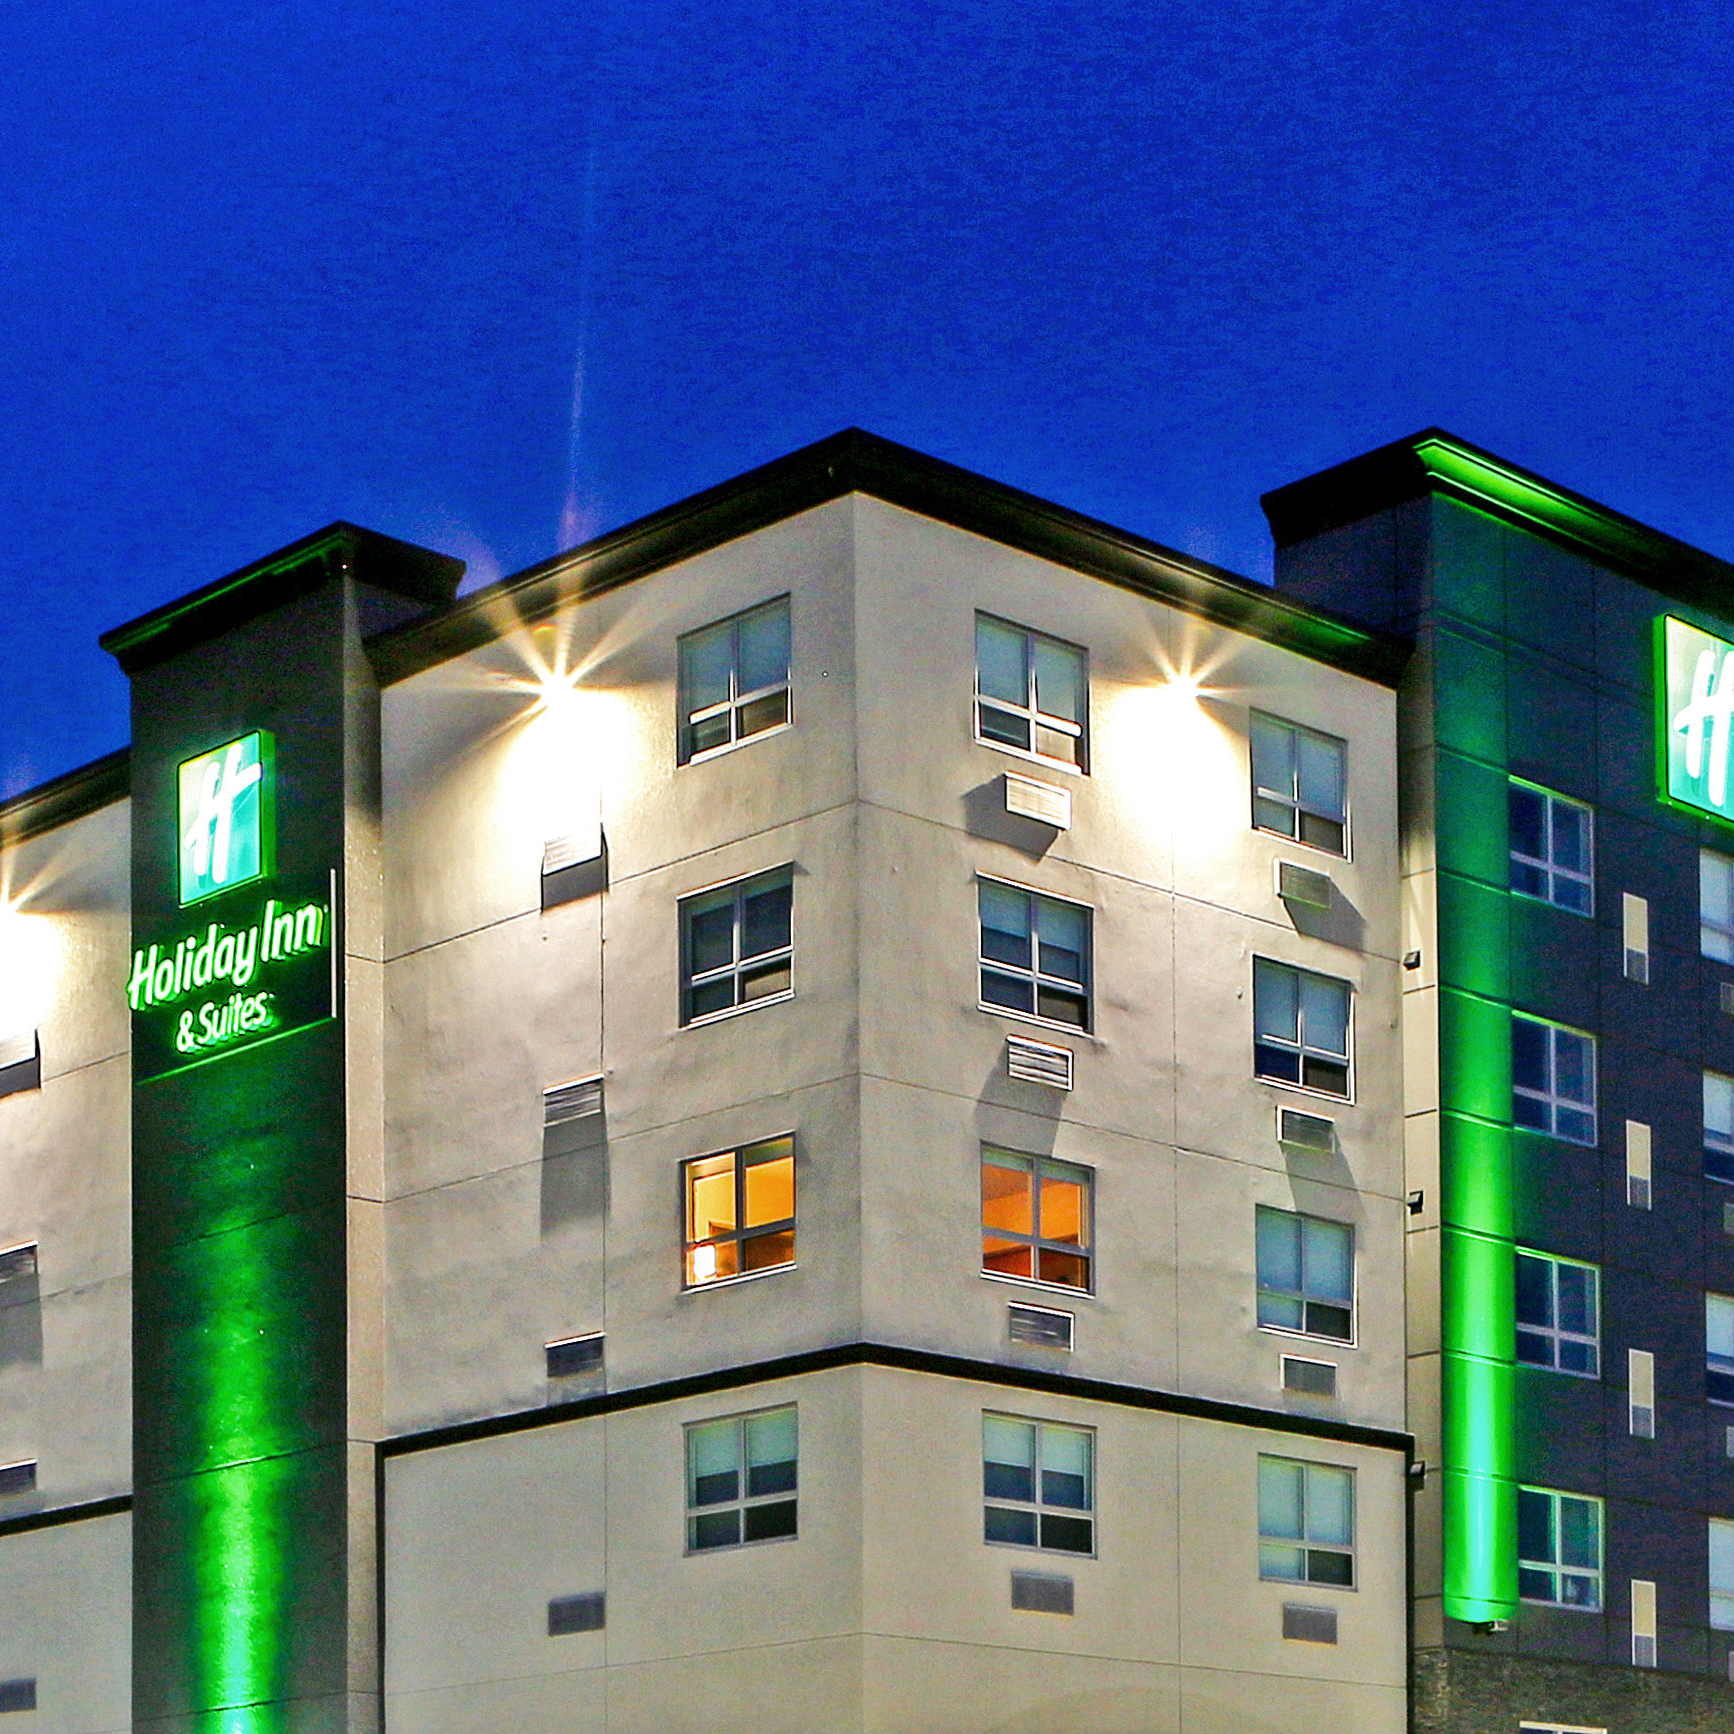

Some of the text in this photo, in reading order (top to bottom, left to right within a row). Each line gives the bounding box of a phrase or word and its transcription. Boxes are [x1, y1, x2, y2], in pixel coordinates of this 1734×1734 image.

[128, 900, 324, 1010] Holiday Inn
[176, 992, 268, 1052] & Suites
